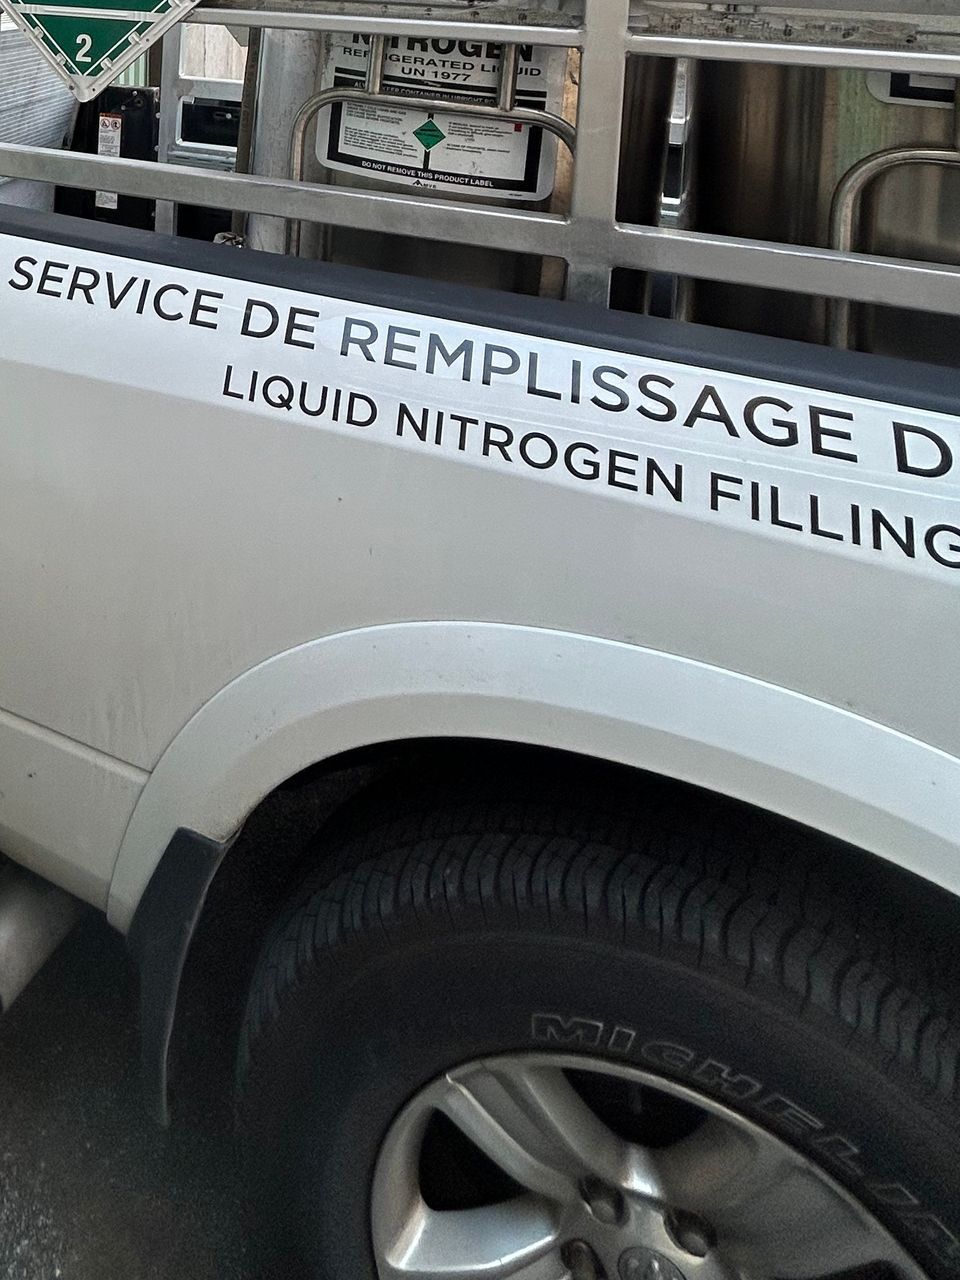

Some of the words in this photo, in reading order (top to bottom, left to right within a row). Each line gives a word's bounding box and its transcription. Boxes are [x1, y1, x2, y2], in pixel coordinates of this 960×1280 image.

[75, 33, 92, 63] 2
[343, 46, 475, 71] REFIGERATED
[481, 63, 542, 77] LIUID
[352, 33, 534, 62] ROGE
[401, 66, 426, 77] UN
[431, 71, 472, 82] 1977
[361, 160, 372, 168] DO
[372, 162, 387, 172] NOT
[387, 166, 416, 177] REMOVE
[417, 170, 434, 180] THIS
[434, 173, 469, 185] PRODUCT
[469, 179, 495, 188] LABEL
[8, 256, 224, 330] SERVICE
[240, 298, 320, 350] DE
[339, 317, 859, 465] REMPLISSAGE
[222, 364, 378, 427] LIQUID
[396, 402, 683, 503] NITROGEN
[710, 471, 960, 569] FILLING
